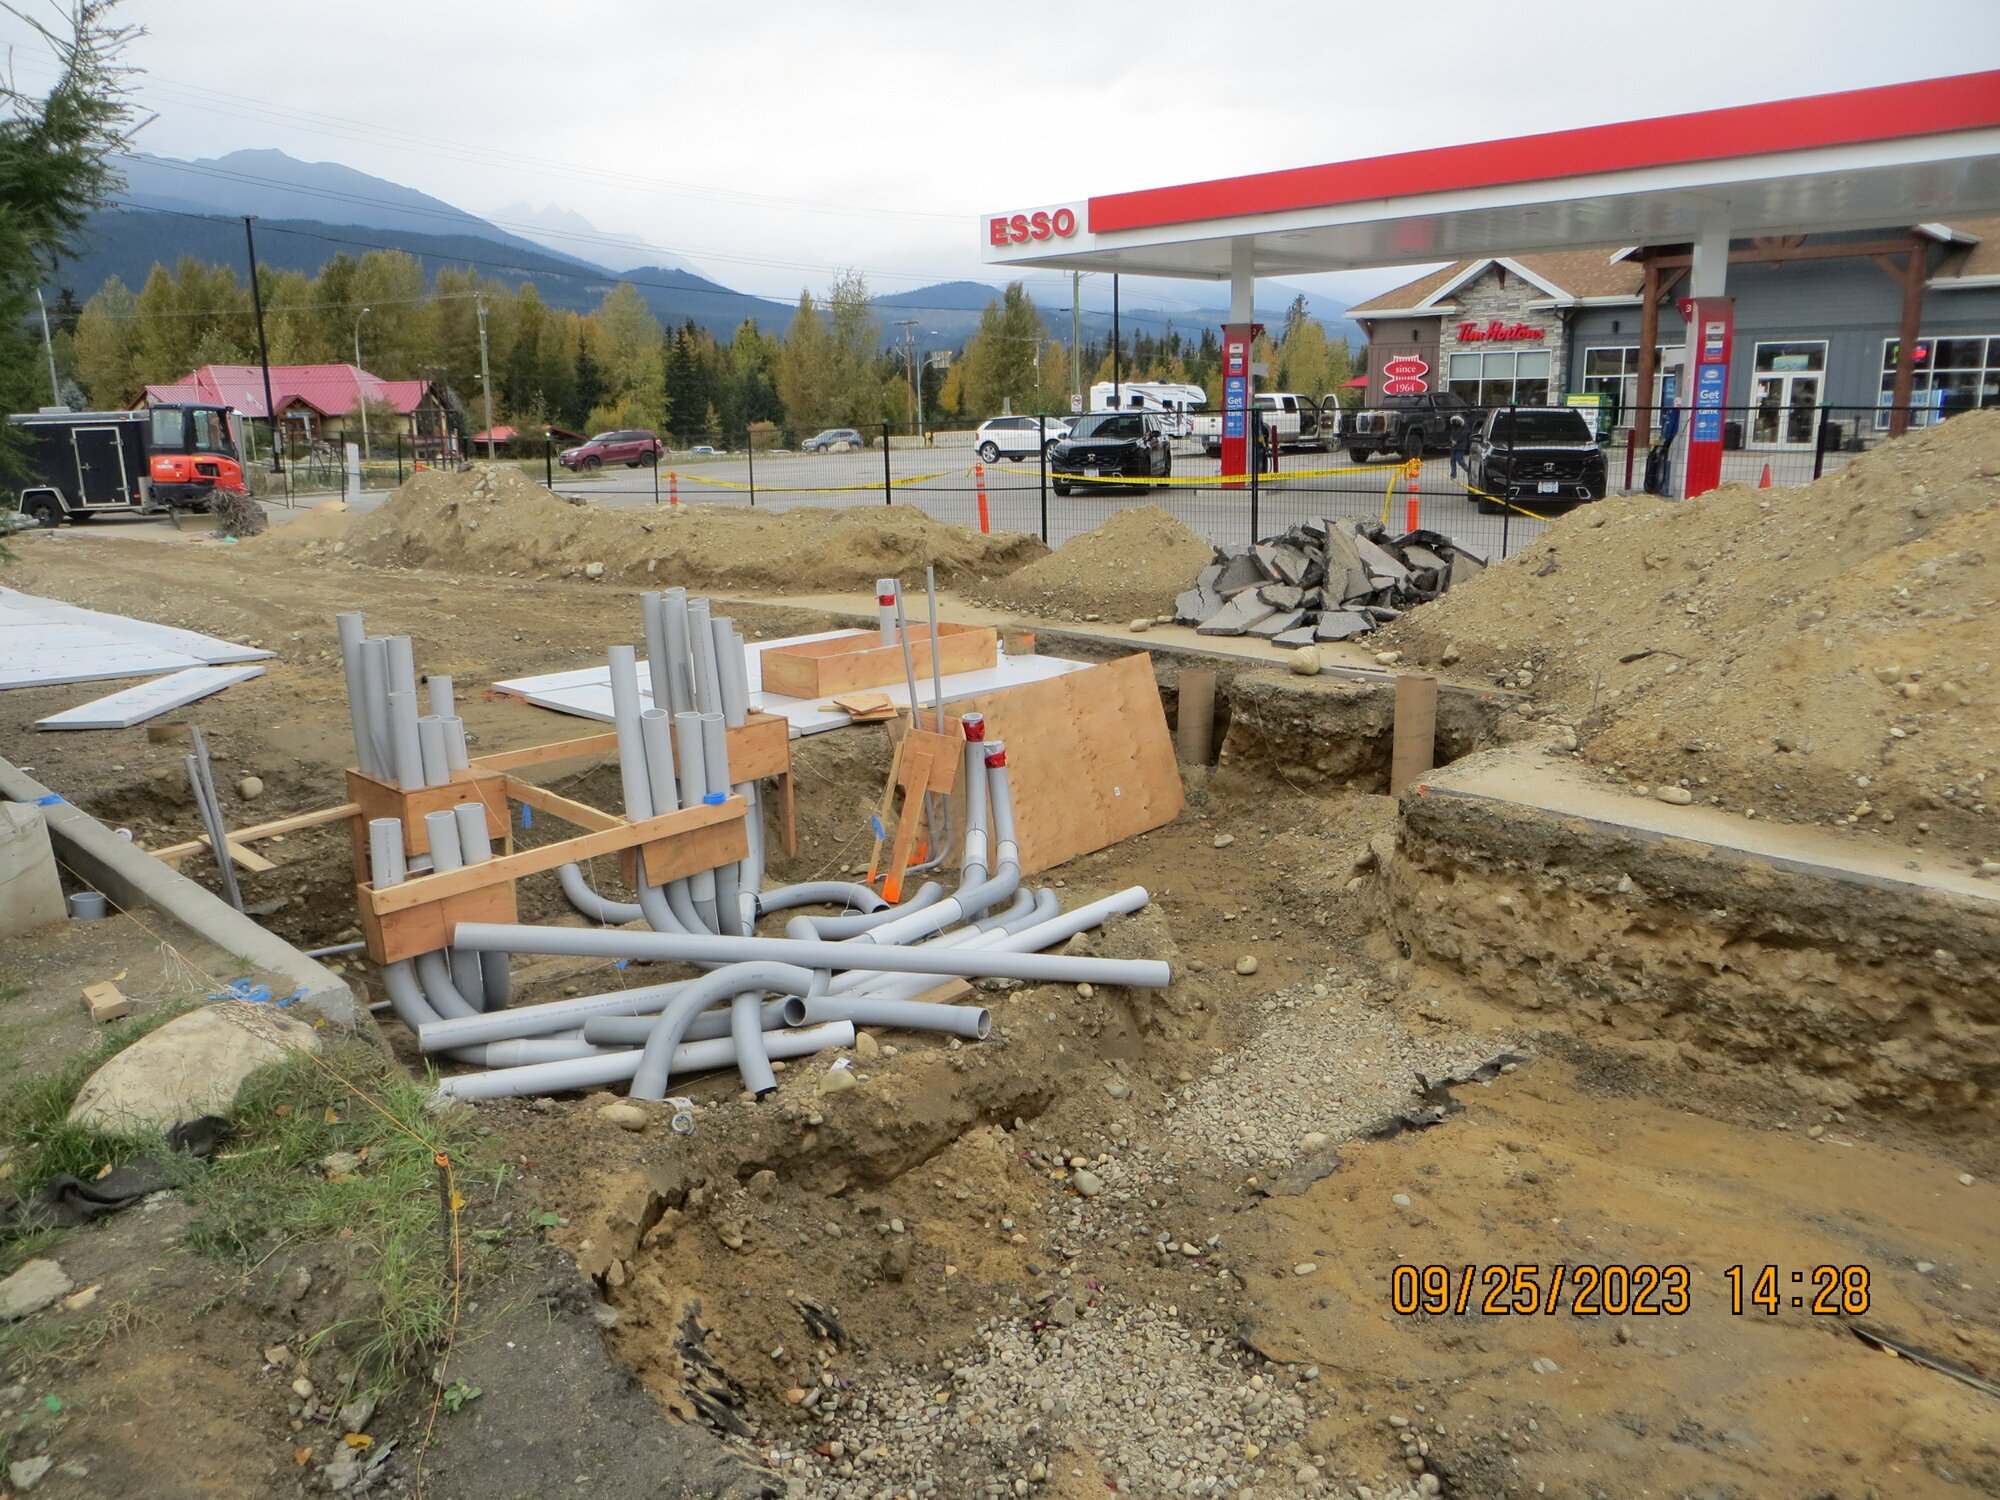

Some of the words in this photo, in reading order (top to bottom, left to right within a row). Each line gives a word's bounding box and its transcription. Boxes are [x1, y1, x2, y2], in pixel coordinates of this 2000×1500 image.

[990, 208, 1076, 246] ESSO
[1685, 304, 1692, 313] 3
[1458, 322, 1483, 342] Tim
[1484, 320, 1545, 341] Hortons
[1395, 364, 1417, 374] since
[1395, 382, 1415, 393] 1964
[1700, 389, 1720, 400] Get
[1227, 396, 1242, 405] Get
